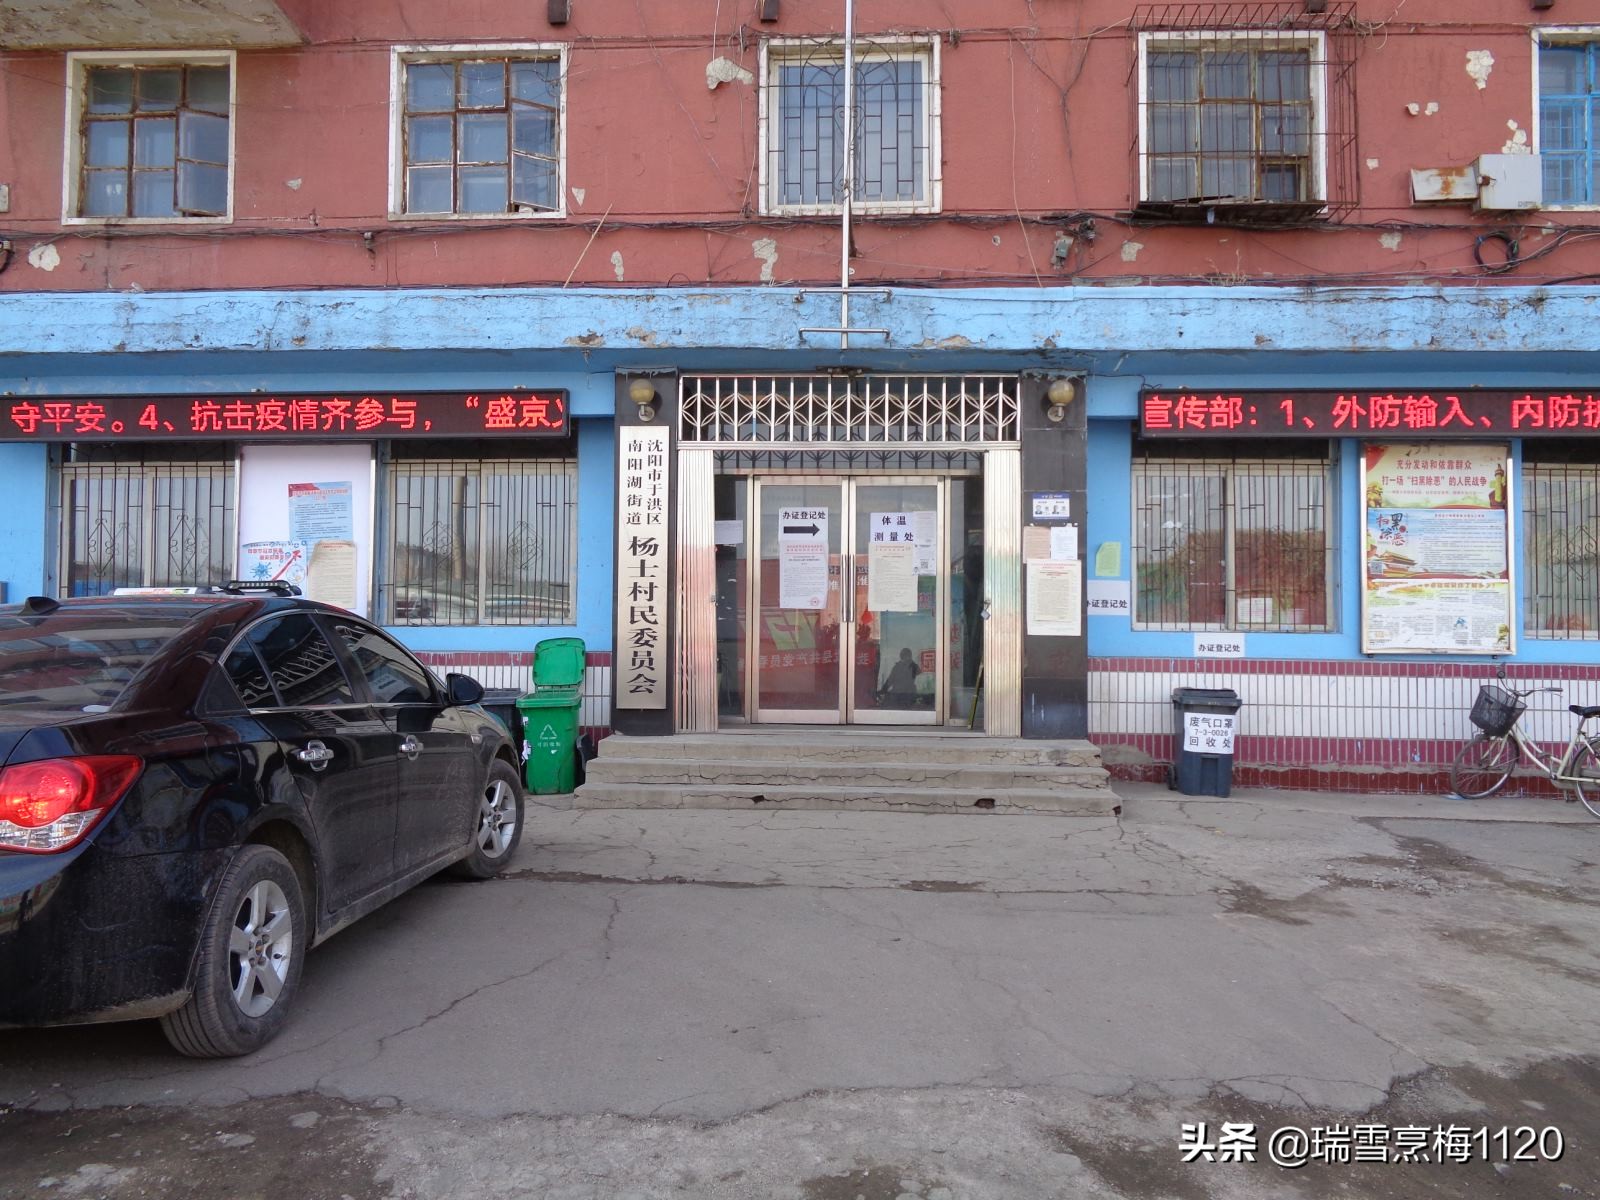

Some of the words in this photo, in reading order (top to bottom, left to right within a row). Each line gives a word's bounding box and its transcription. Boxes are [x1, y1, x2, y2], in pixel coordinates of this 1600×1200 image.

[626, 439, 643, 525] 南阳湖街道
[647, 439, 663, 525] 沈阳市于洪区
[782, 511, 826, 520] 办证登记处
[881, 515, 907, 526] 体温
[874, 532, 914, 542] 测量处
[626, 535, 660, 694] 杨士村民委员会
[1198, 644, 1240, 653] 办证登记处
[1189, 717, 1233, 728] 废气口罩
[1189, 736, 1231, 748] 回收处
